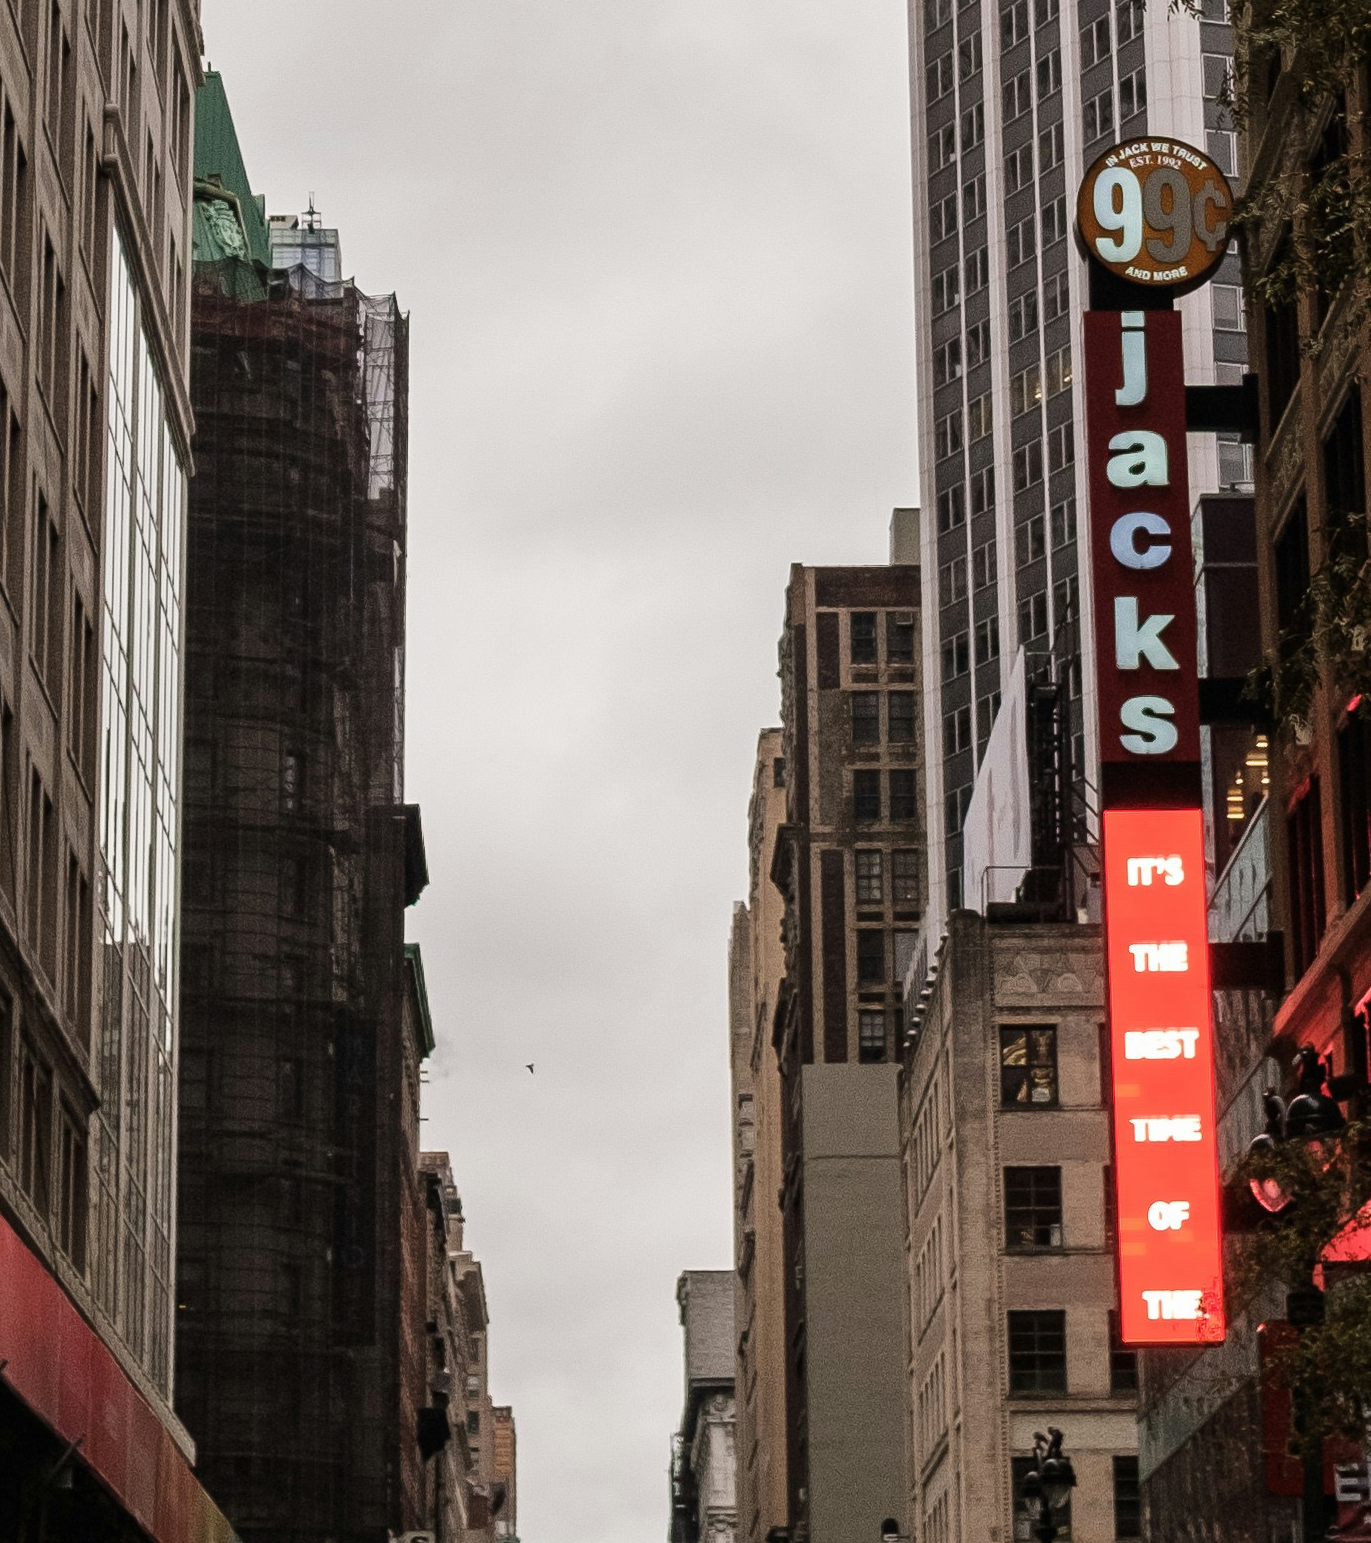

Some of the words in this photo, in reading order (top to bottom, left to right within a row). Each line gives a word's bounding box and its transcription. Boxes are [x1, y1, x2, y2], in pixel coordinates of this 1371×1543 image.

[1105, 154, 1118, 167] IN
[1118, 142, 1149, 160] JACK
[1151, 143, 1169, 152] WE
[1172, 145, 1208, 171] TRUST
[1156, 155, 1183, 170] 1992
[1125, 266, 1150, 280] AND
[1153, 266, 1188, 281] MORE
[1106, 310, 1181, 755] jacks
[1126, 856, 1185, 887] IT'S
[1130, 941, 1189, 972] THE
[1125, 1028, 1199, 1060] BEST
[1130, 1114, 1203, 1143] TIME
[1147, 1199, 1190, 1231] OF
